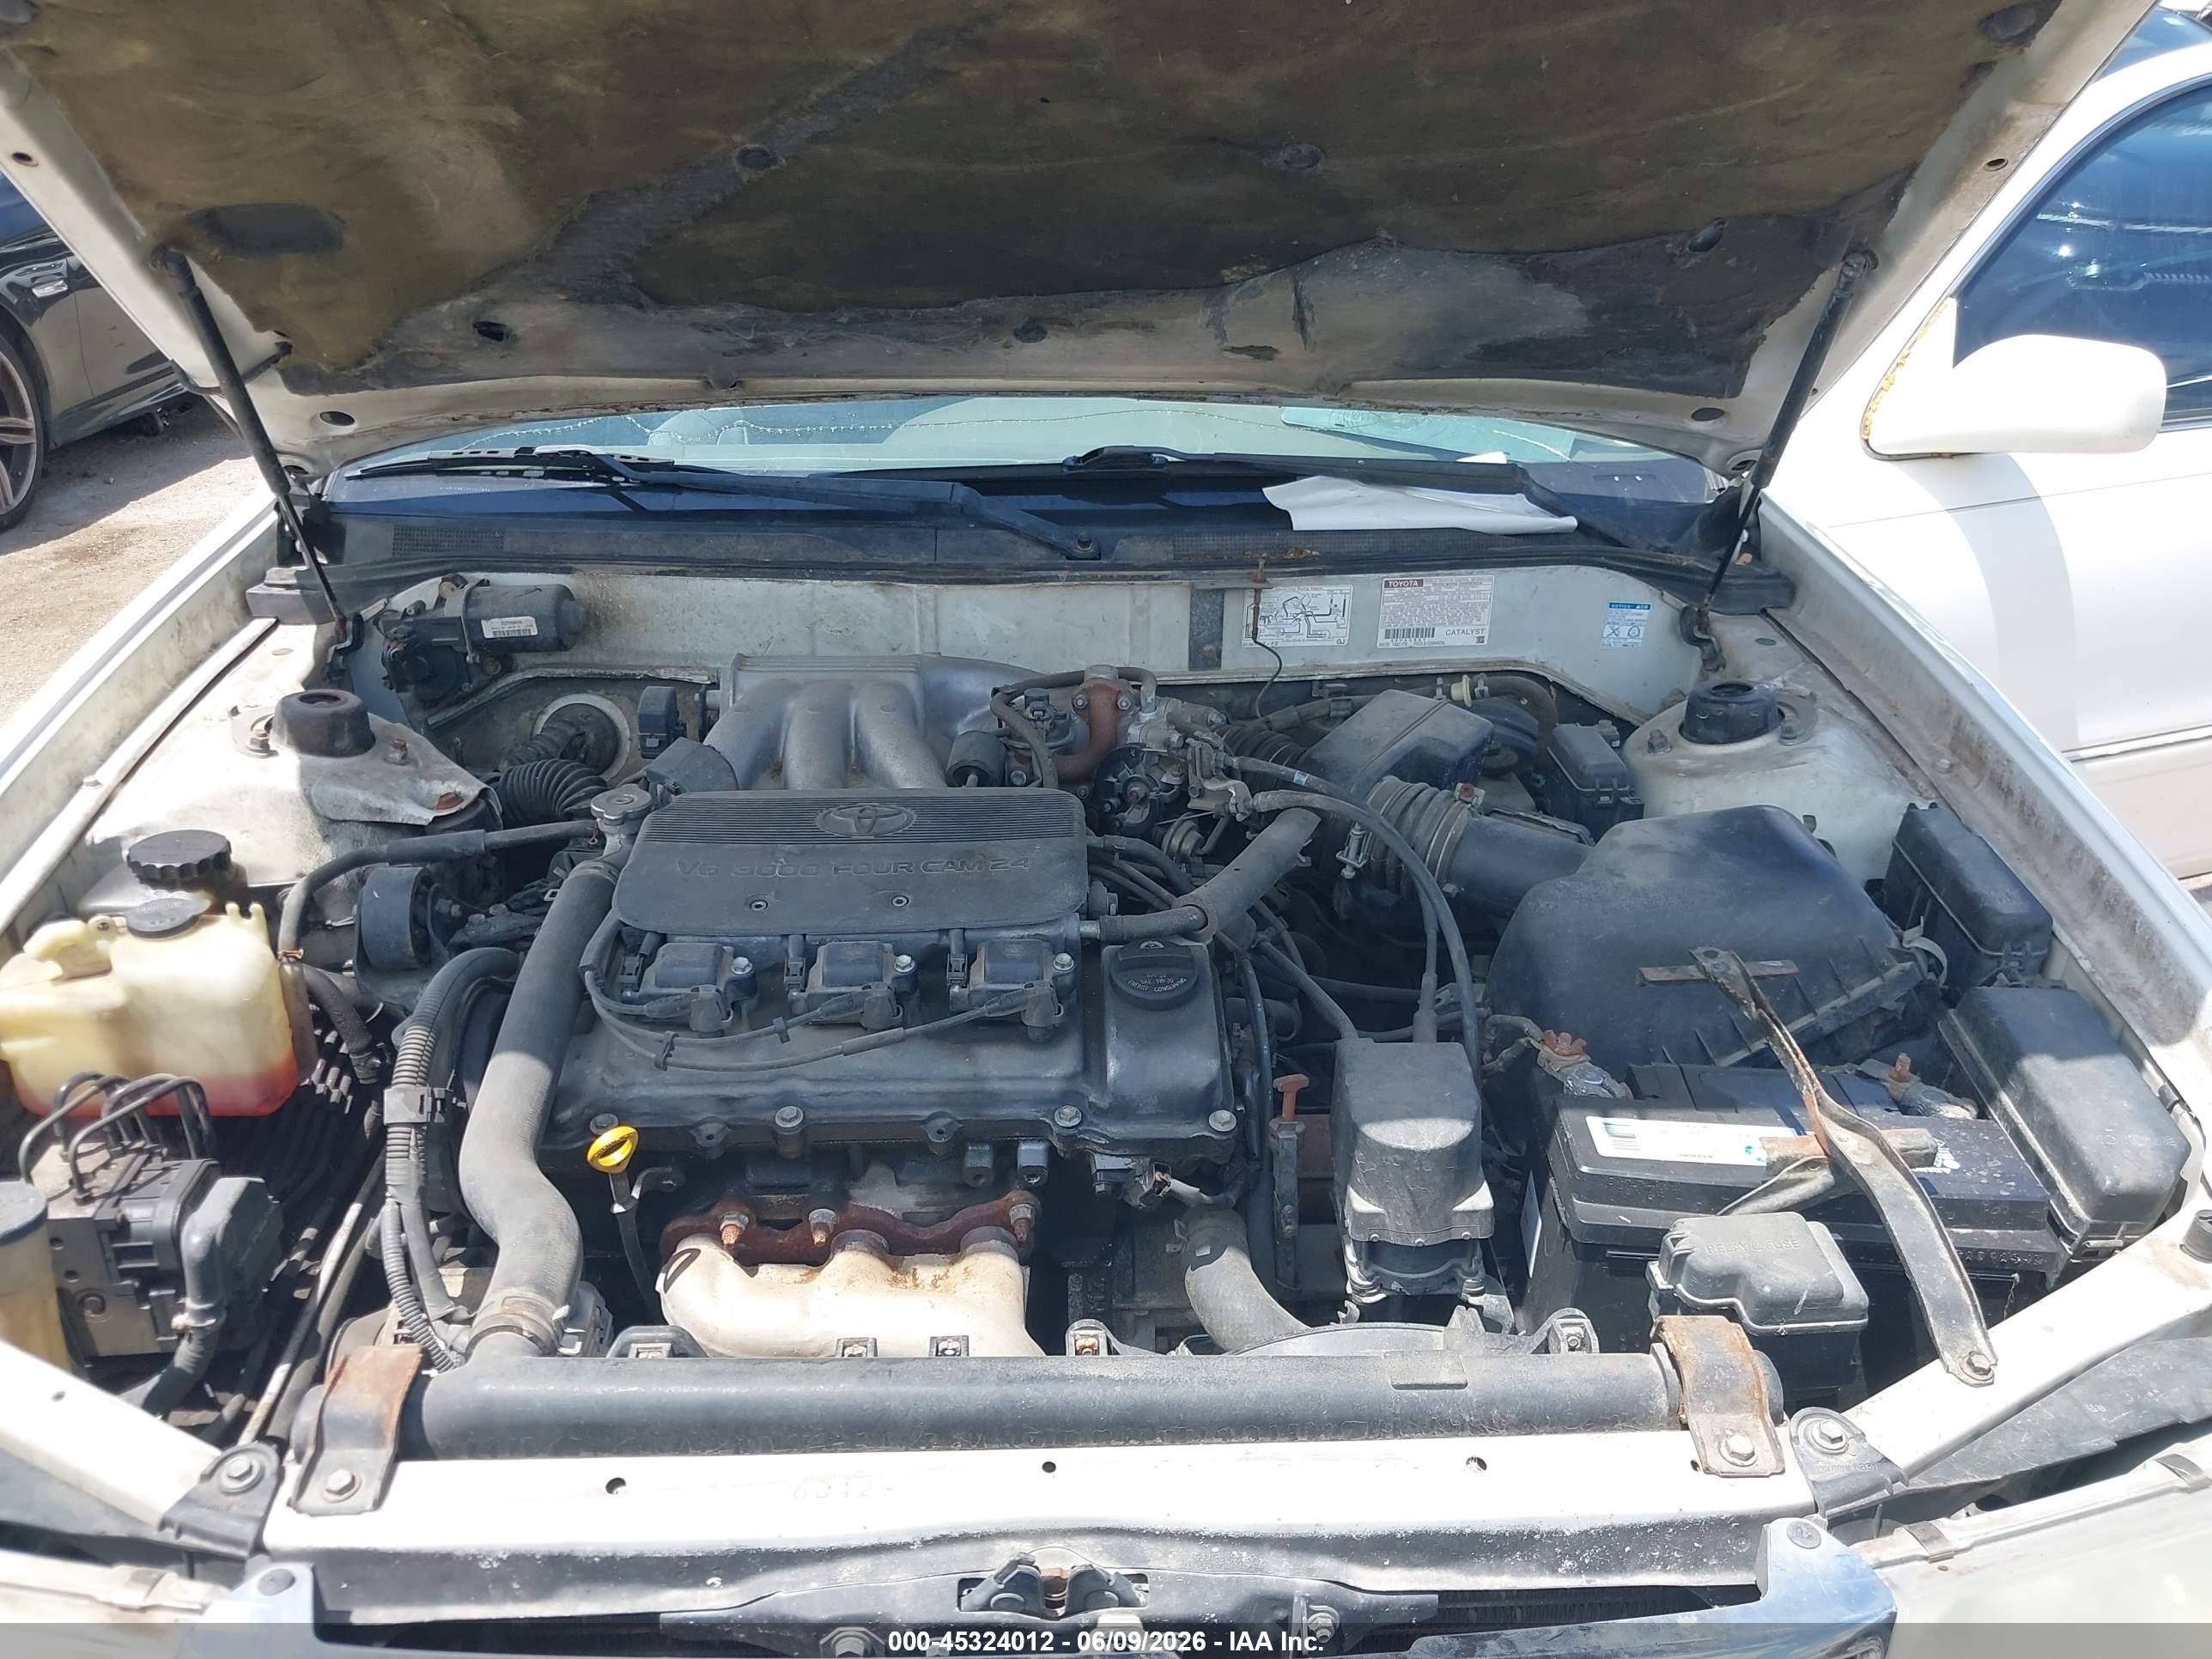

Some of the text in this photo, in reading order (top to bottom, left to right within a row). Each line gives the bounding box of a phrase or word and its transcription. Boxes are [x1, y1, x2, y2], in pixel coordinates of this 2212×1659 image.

[676, 858, 1030, 878] V6 3000 FOUR CAM 24
[1704, 1243, 1747, 1254] RELAY
[1766, 1239, 1800, 1250] FUSE
